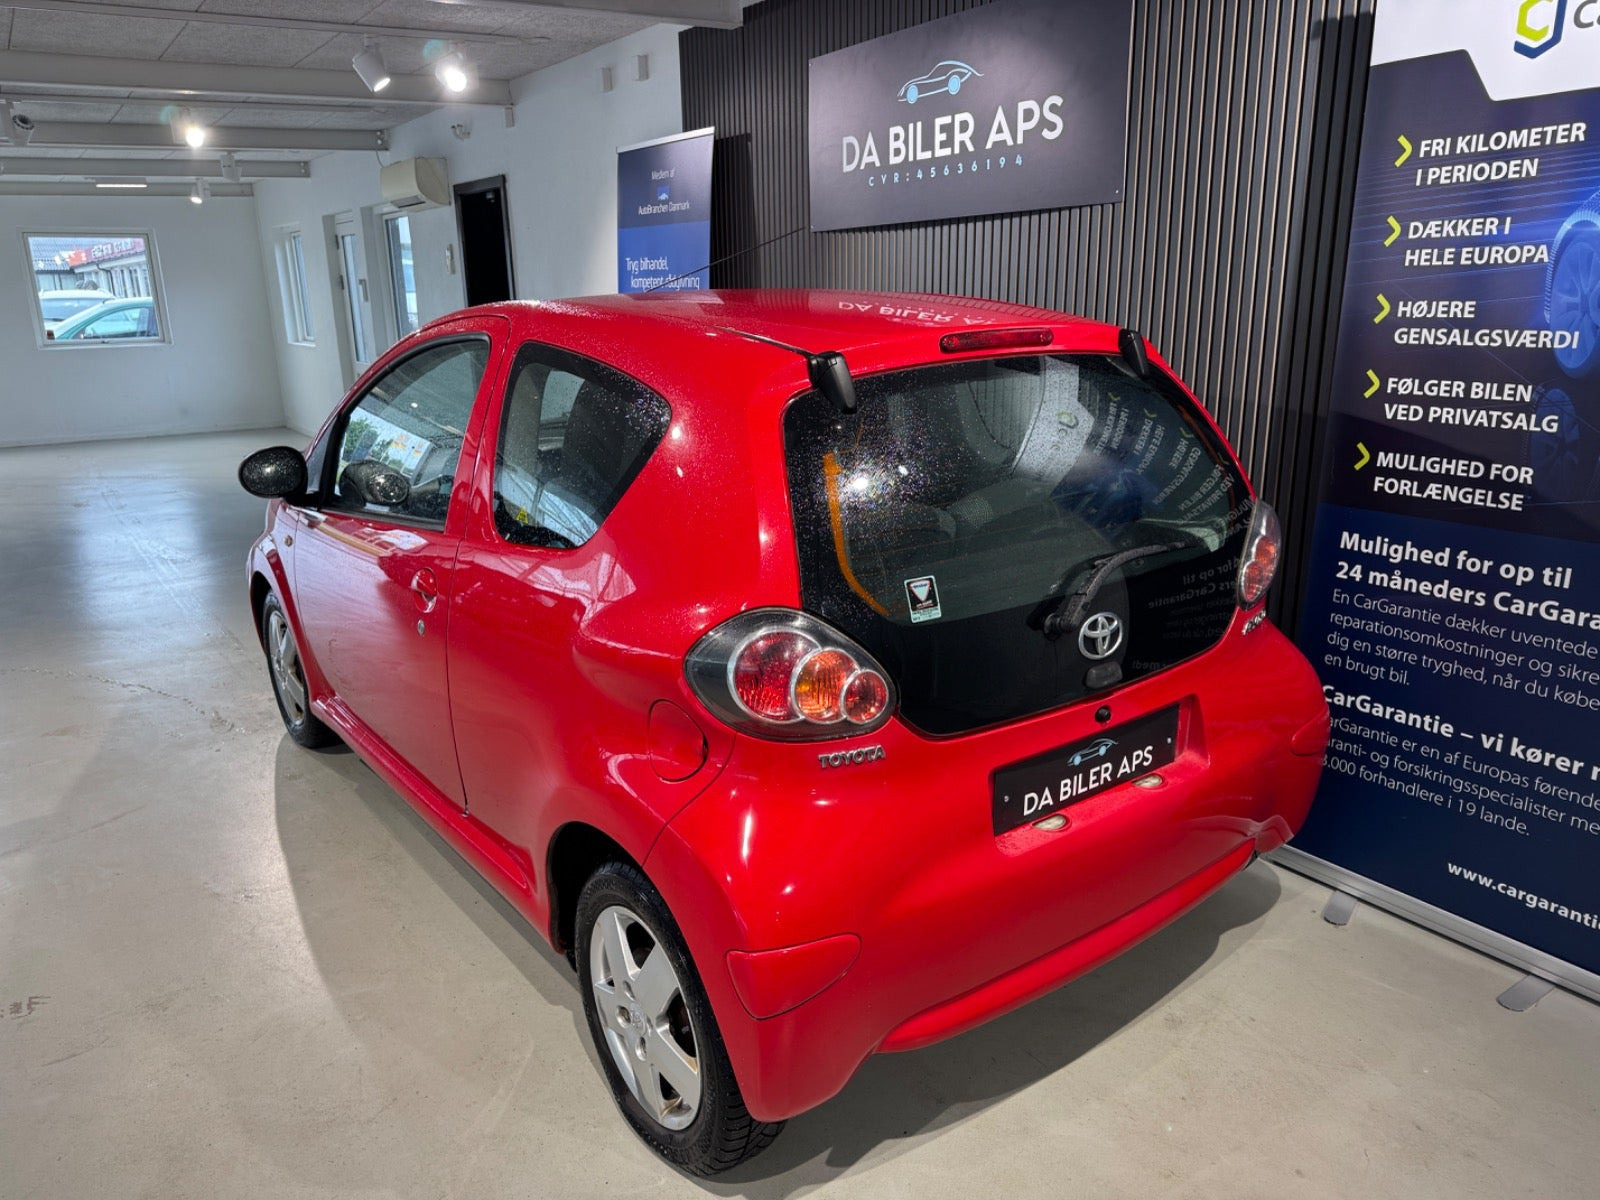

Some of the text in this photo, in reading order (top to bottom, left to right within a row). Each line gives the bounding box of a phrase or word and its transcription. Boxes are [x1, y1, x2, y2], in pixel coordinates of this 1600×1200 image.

[1574, 0, 1600, 29] C
[842, 94, 1064, 173] DA BILER APS
[1419, 122, 1586, 157] FRI KILOMETER
[1416, 159, 1539, 186] I PERIODEN
[1408, 217, 1511, 239] DÆKKER I
[626, 257, 639, 274] Tryg
[1404, 245, 1549, 266] HELE EUROPA
[1397, 300, 1476, 318] HØJERE
[1394, 327, 1579, 349] GENSALGSVÆRDI
[1386, 377, 1533, 402] FØLGER BILEN
[1384, 404, 1559, 433] VED PRIVATSALG
[1376, 451, 1533, 484] MULIGHED FOR
[1373, 476, 1524, 511] FORLÆNGELSE
[1340, 531, 1573, 589] Mulighed for op til
[1335, 561, 1362, 581] 24
[1368, 570, 1486, 606] måneders
[1332, 589, 1598, 660] En CarGarantie dækker uventede
[1330, 612, 1600, 685] reparationsomkostninger og sikre
[1324, 654, 1410, 686] en brugt bil.
[1327, 632, 1600, 711] dig en større tryghed, når du købe
[1322, 684, 1454, 738] CarGarantie
[1481, 733, 1504, 752] vi
[1509, 737, 1584, 775] kører
[818, 745, 886, 768] TOYOTA
[1402, 739, 1418, 752] er
[1420, 745, 1440, 759] en
[1443, 750, 1461, 766] af
[1462, 756, 1529, 789] Europas
[1023, 745, 1153, 816] DA BILER APS
[1370, 751, 1389, 768] og
[1393, 755, 1566, 823] forsikringsspecialister
[1359, 765, 1443, 806] forhandlere
[1448, 797, 1452, 808] i
[1458, 798, 1476, 816] 19
[1480, 806, 1530, 836] lande.
[1447, 862, 1600, 930] www.cargaranti
